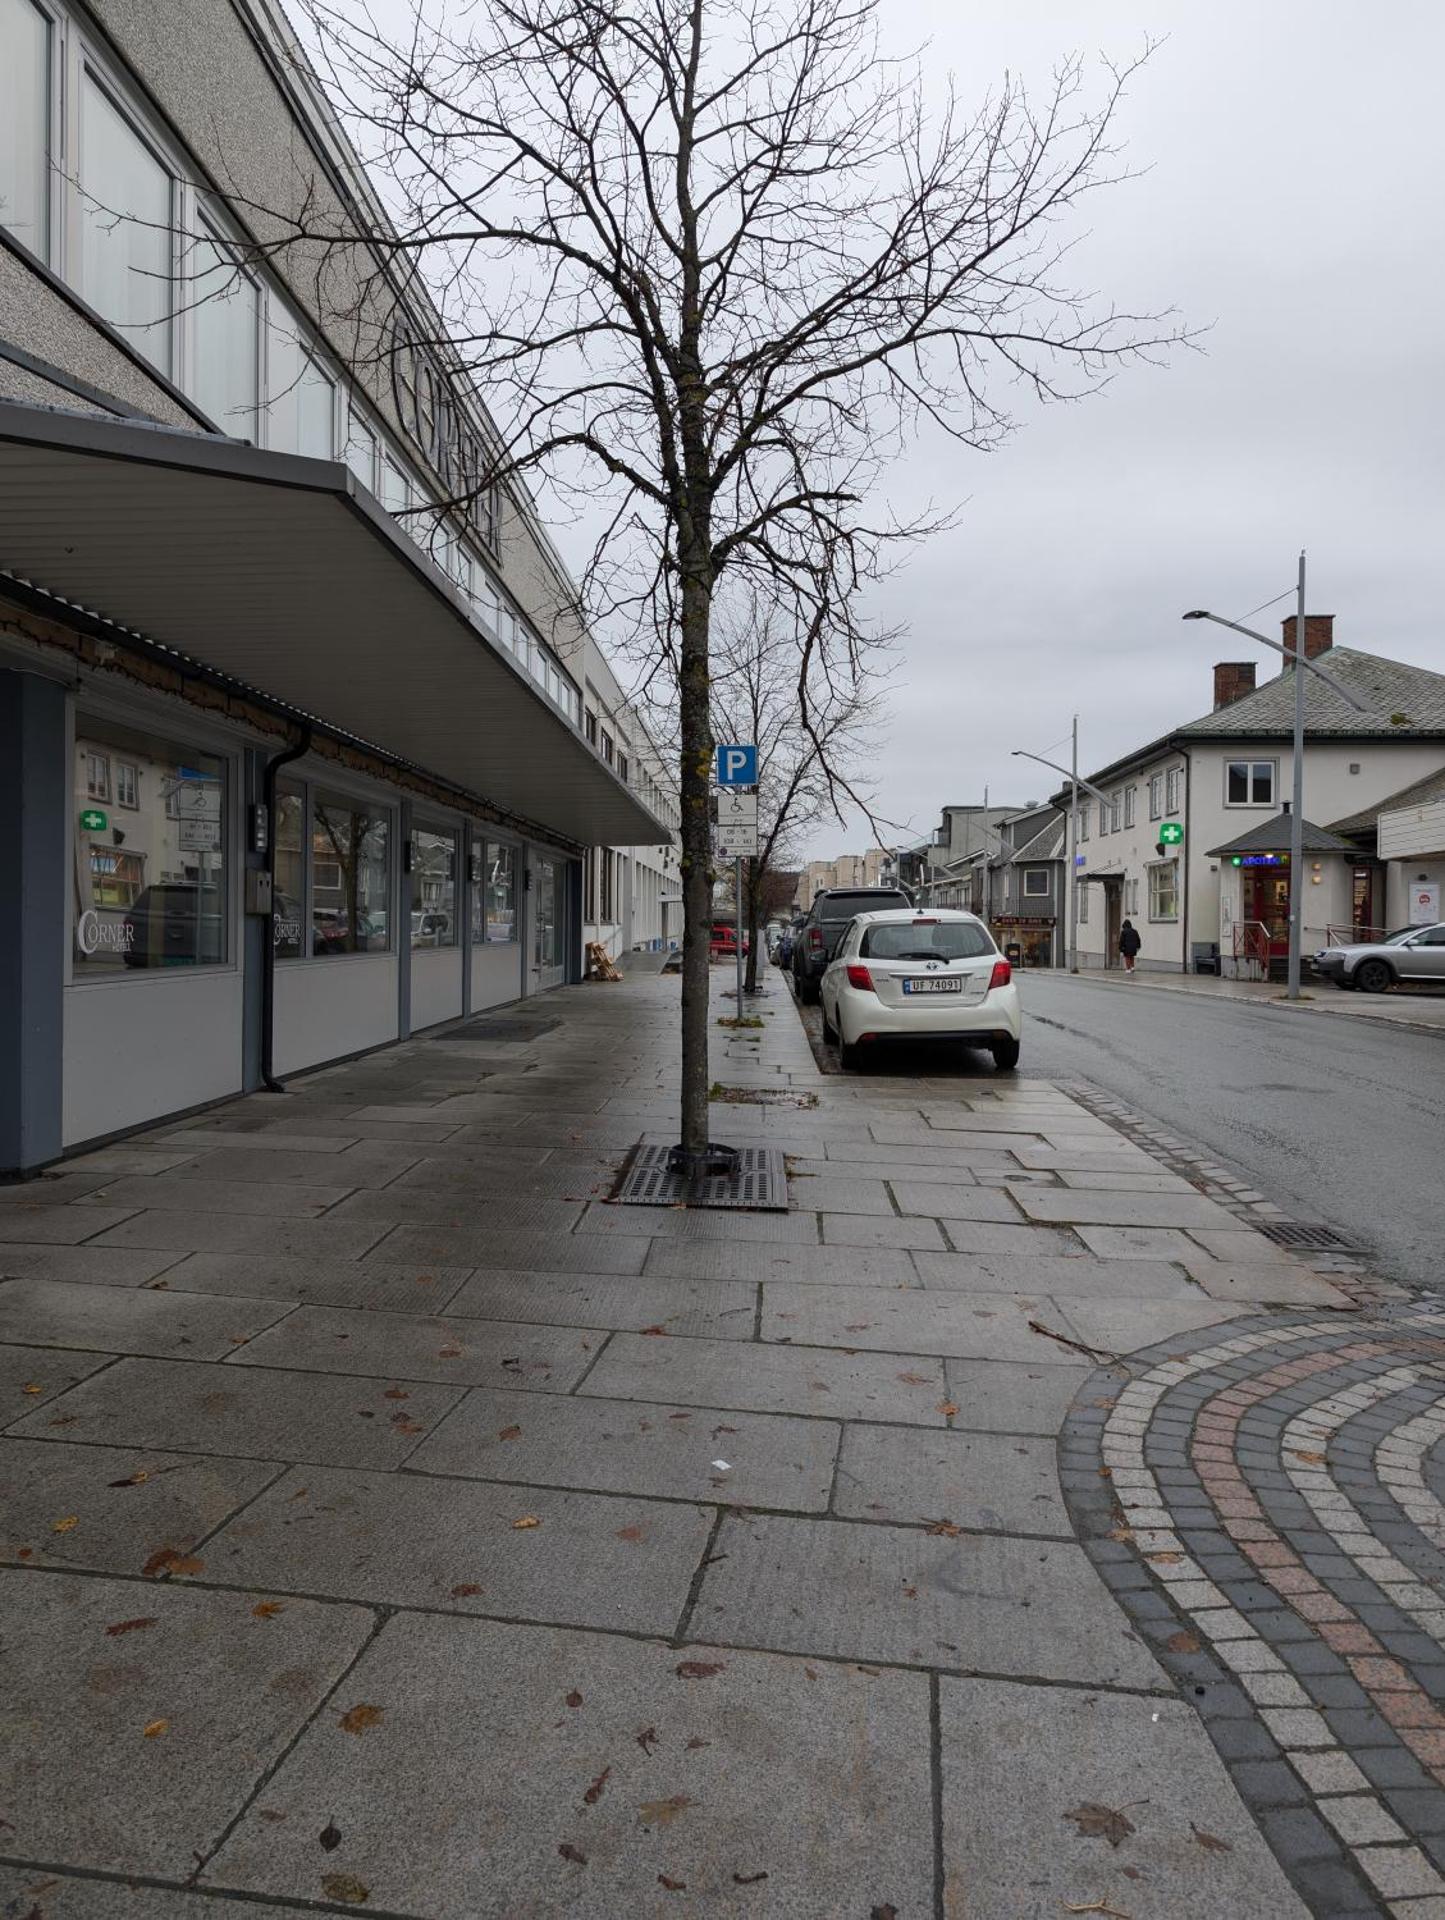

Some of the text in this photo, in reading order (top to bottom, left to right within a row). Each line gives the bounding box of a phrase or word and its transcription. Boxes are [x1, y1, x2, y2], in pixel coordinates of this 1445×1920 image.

[727, 751, 747, 780] P
[79, 910, 134, 954] CORNER
[913, 980, 959, 990] UF 74091
